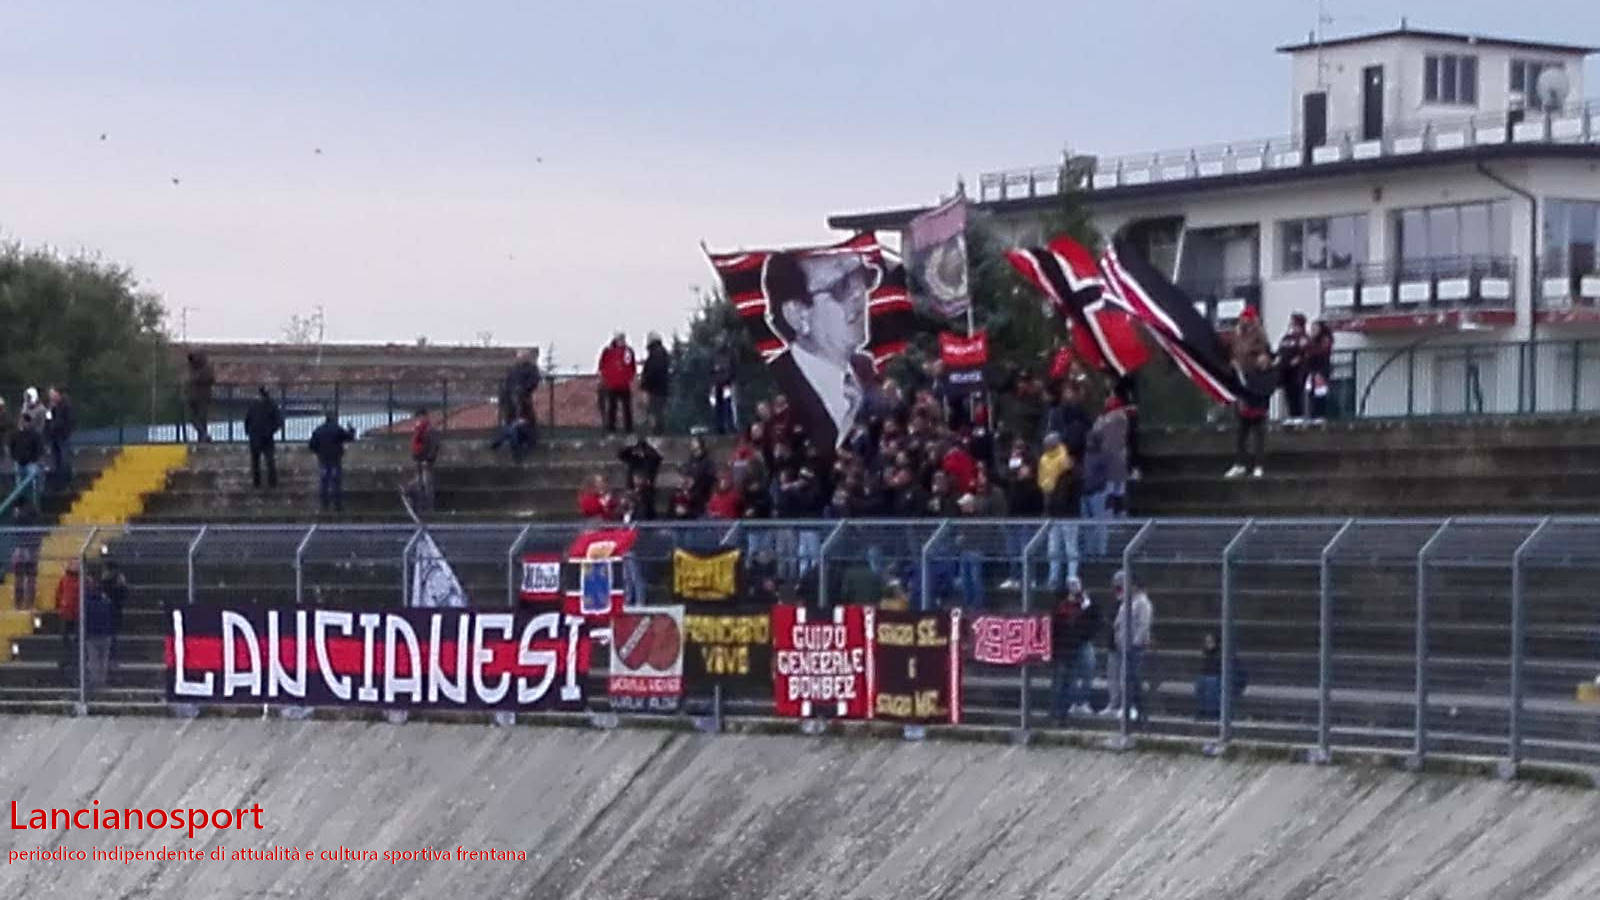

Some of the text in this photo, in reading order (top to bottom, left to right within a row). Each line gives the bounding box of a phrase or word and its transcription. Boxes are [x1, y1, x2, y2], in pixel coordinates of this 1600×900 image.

[792, 625, 847, 650] GUIDO
[172, 609, 585, 704] LANCIANESI
[777, 648, 864, 675] GENERALE
[788, 675, 856, 700] BOMBER
